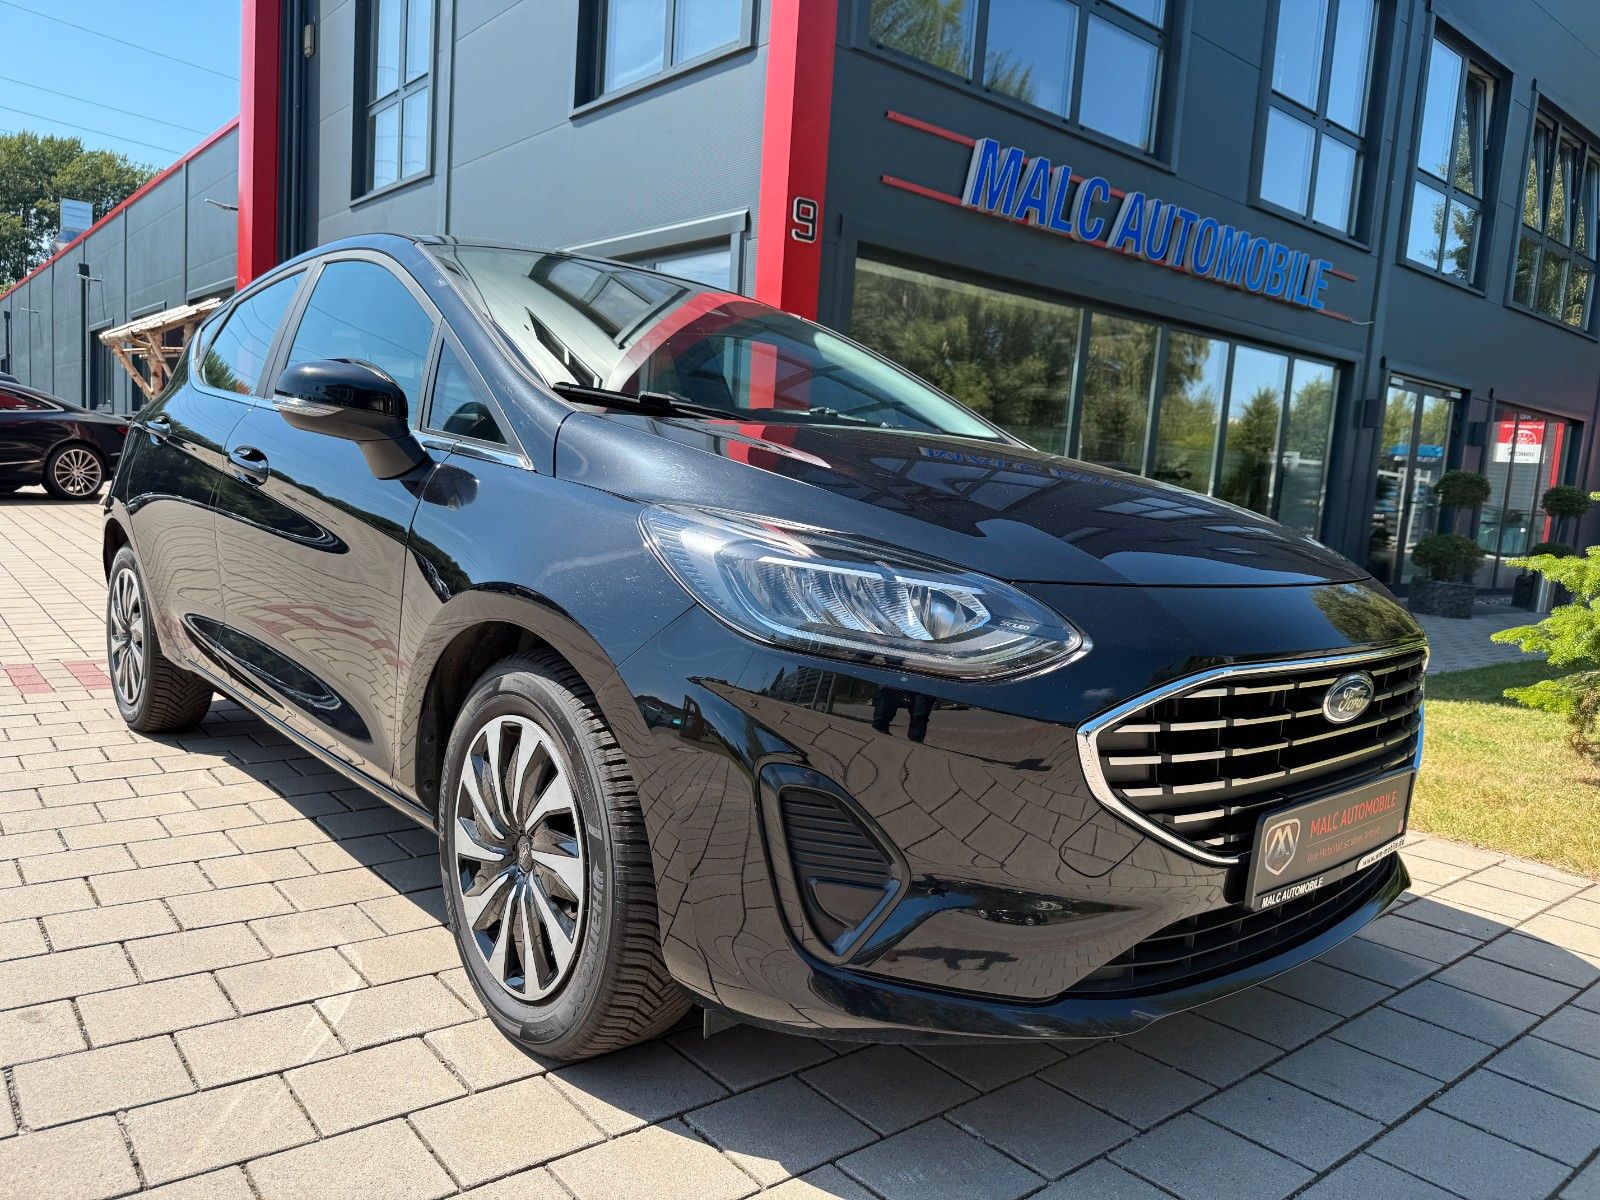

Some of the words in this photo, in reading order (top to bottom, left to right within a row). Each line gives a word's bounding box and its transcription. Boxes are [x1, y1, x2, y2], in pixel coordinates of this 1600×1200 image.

[791, 196, 819, 244] 9
[963, 137, 1111, 242] MALC
[1107, 191, 1334, 310] AUTOMOBILE
[1338, 685, 1368, 712] Ford
[1310, 811, 1340, 838] MALC
[1340, 790, 1397, 827] AUTOMOBILE
[1261, 892, 1282, 909] MALC
[1281, 877, 1324, 901] AUTOMOBILE
